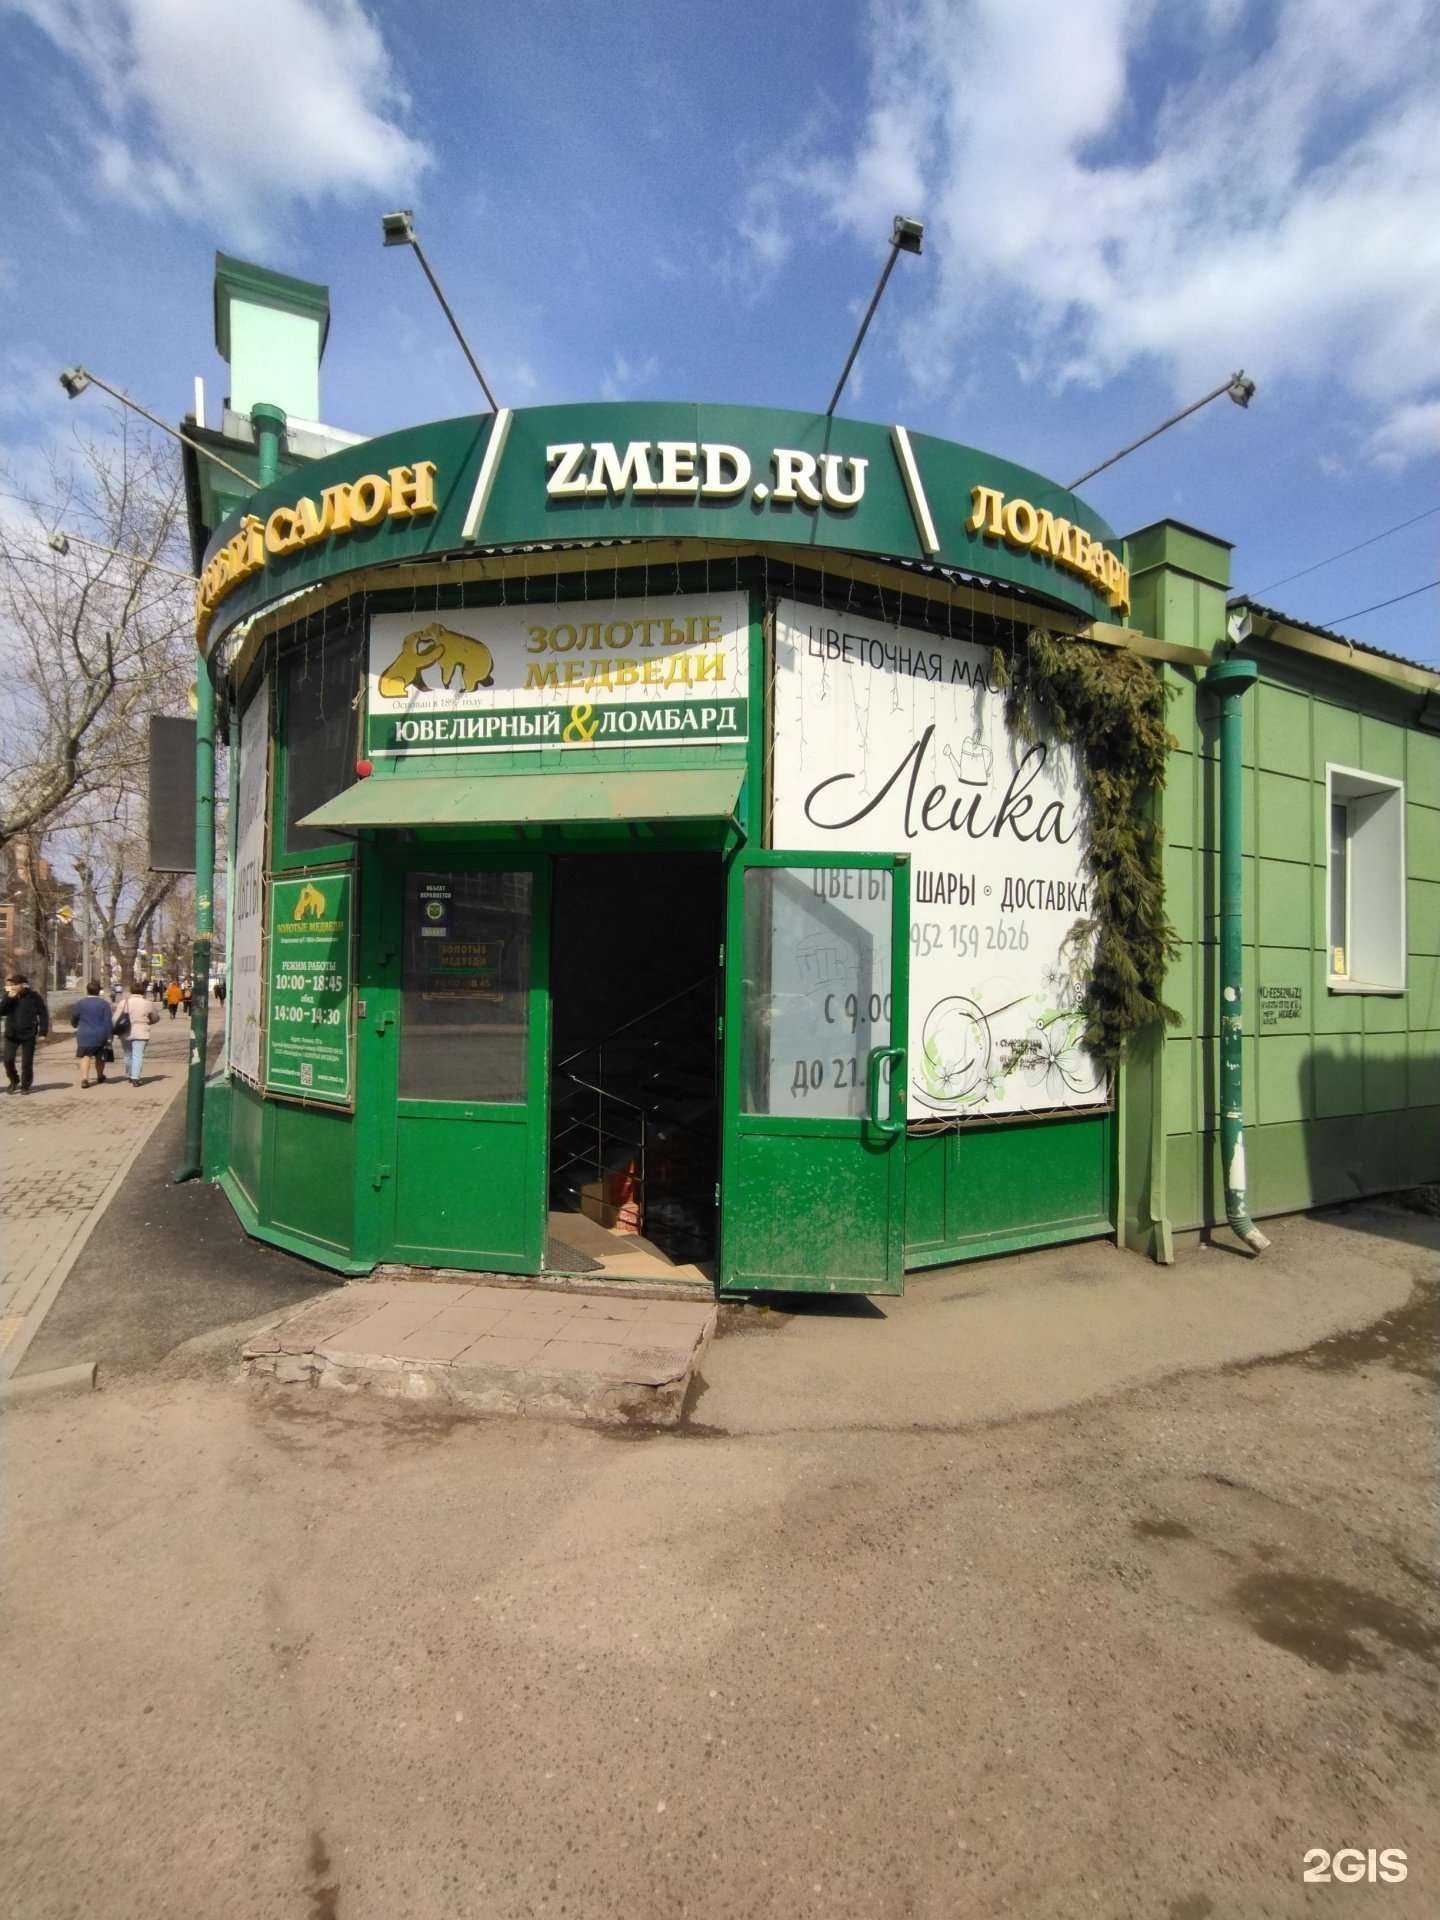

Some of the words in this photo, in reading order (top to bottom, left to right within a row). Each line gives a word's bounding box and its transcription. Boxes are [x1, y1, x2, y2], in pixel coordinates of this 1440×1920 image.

[546, 441, 869, 509] ZMED.RU
[265, 461, 438, 554] САЛОН
[524, 616, 723, 653] ЗОЛОТЫЕ
[808, 625, 943, 682] ЦВЕТОЧНАЯ
[523, 652, 727, 694] МЕДВЕДИ
[395, 711, 561, 742] ЮВЕЛИРНЫЙ
[563, 703, 601, 744] &
[600, 707, 737, 733] ЛОМБАРД
[804, 723, 1077, 845] Лейка
[916, 870, 976, 906] ШАРЫ
[1001, 876, 1088, 913] ДОСТАВКА
[951, 923, 980, 957] 159
[987, 918, 1030, 951] 2626
